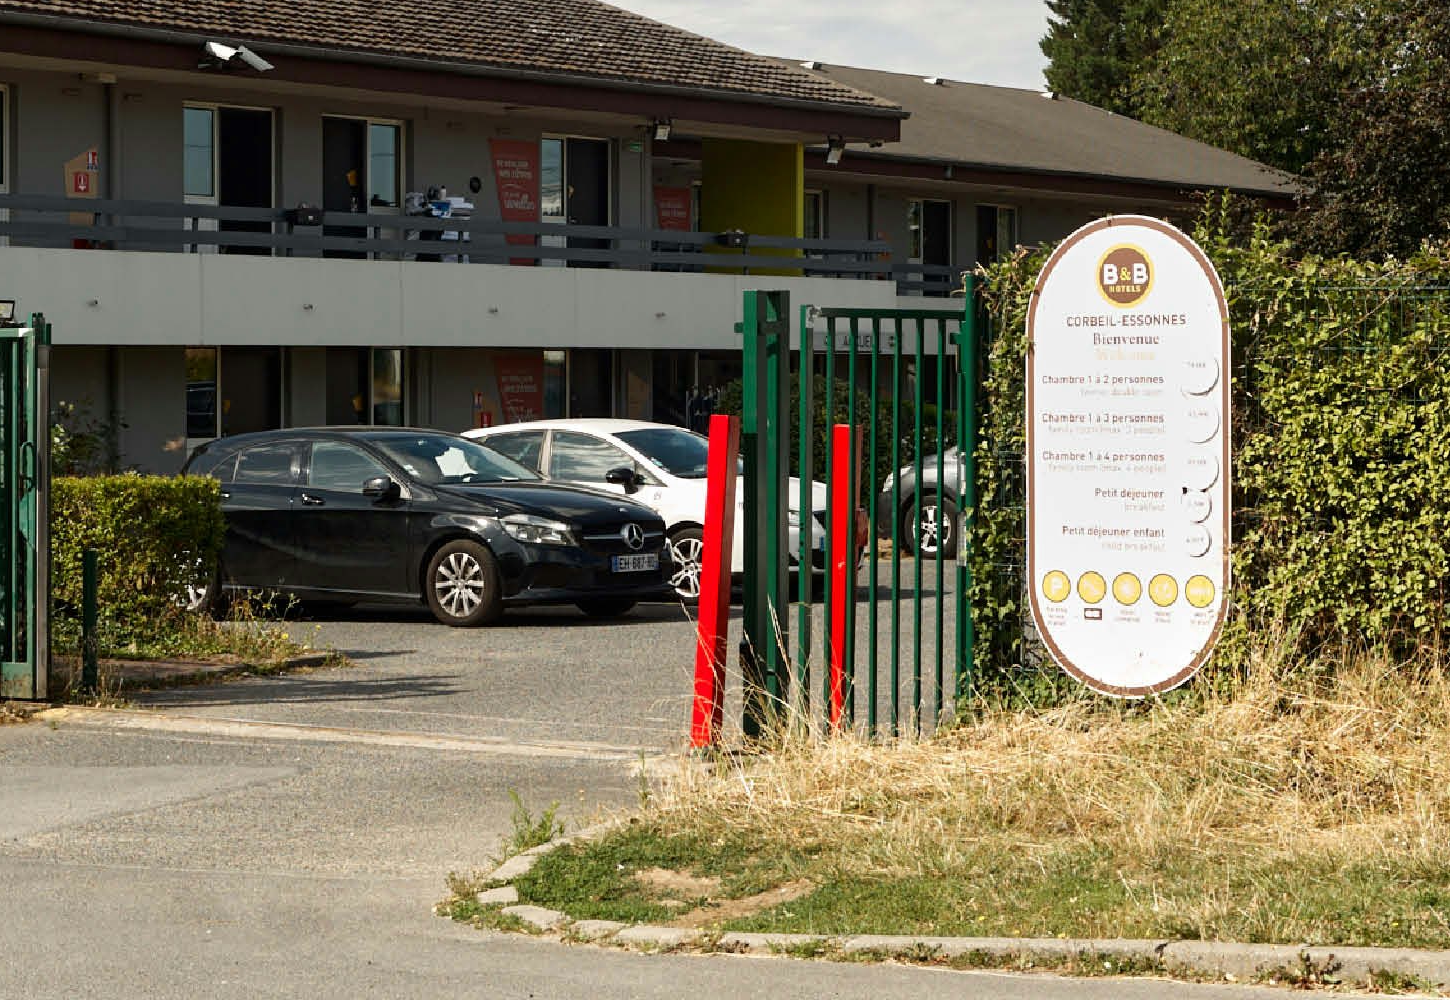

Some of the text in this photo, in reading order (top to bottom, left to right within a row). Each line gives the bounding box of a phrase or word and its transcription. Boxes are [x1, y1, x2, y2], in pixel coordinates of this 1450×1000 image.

[1103, 262, 1148, 285] B&B
[1109, 284, 1141, 293] HOTELS
[1066, 314, 1187, 327] CORBEIL-ESSONNES
[1093, 332, 1160, 345] Bienvenue
[1042, 375, 1085, 384] Chambre
[1103, 375, 1109, 384] 2
[1112, 376, 1164, 387] personnes
[1042, 413, 1085, 423] Chambre
[1112, 414, 1164, 425] personnes
[1042, 451, 1085, 461] Chambre
[1103, 451, 1110, 461] 4
[1112, 452, 1165, 463] personnes
[1094, 487, 1118, 498] Petit
[1062, 525, 1165, 539] Petit déjeuner enfant
